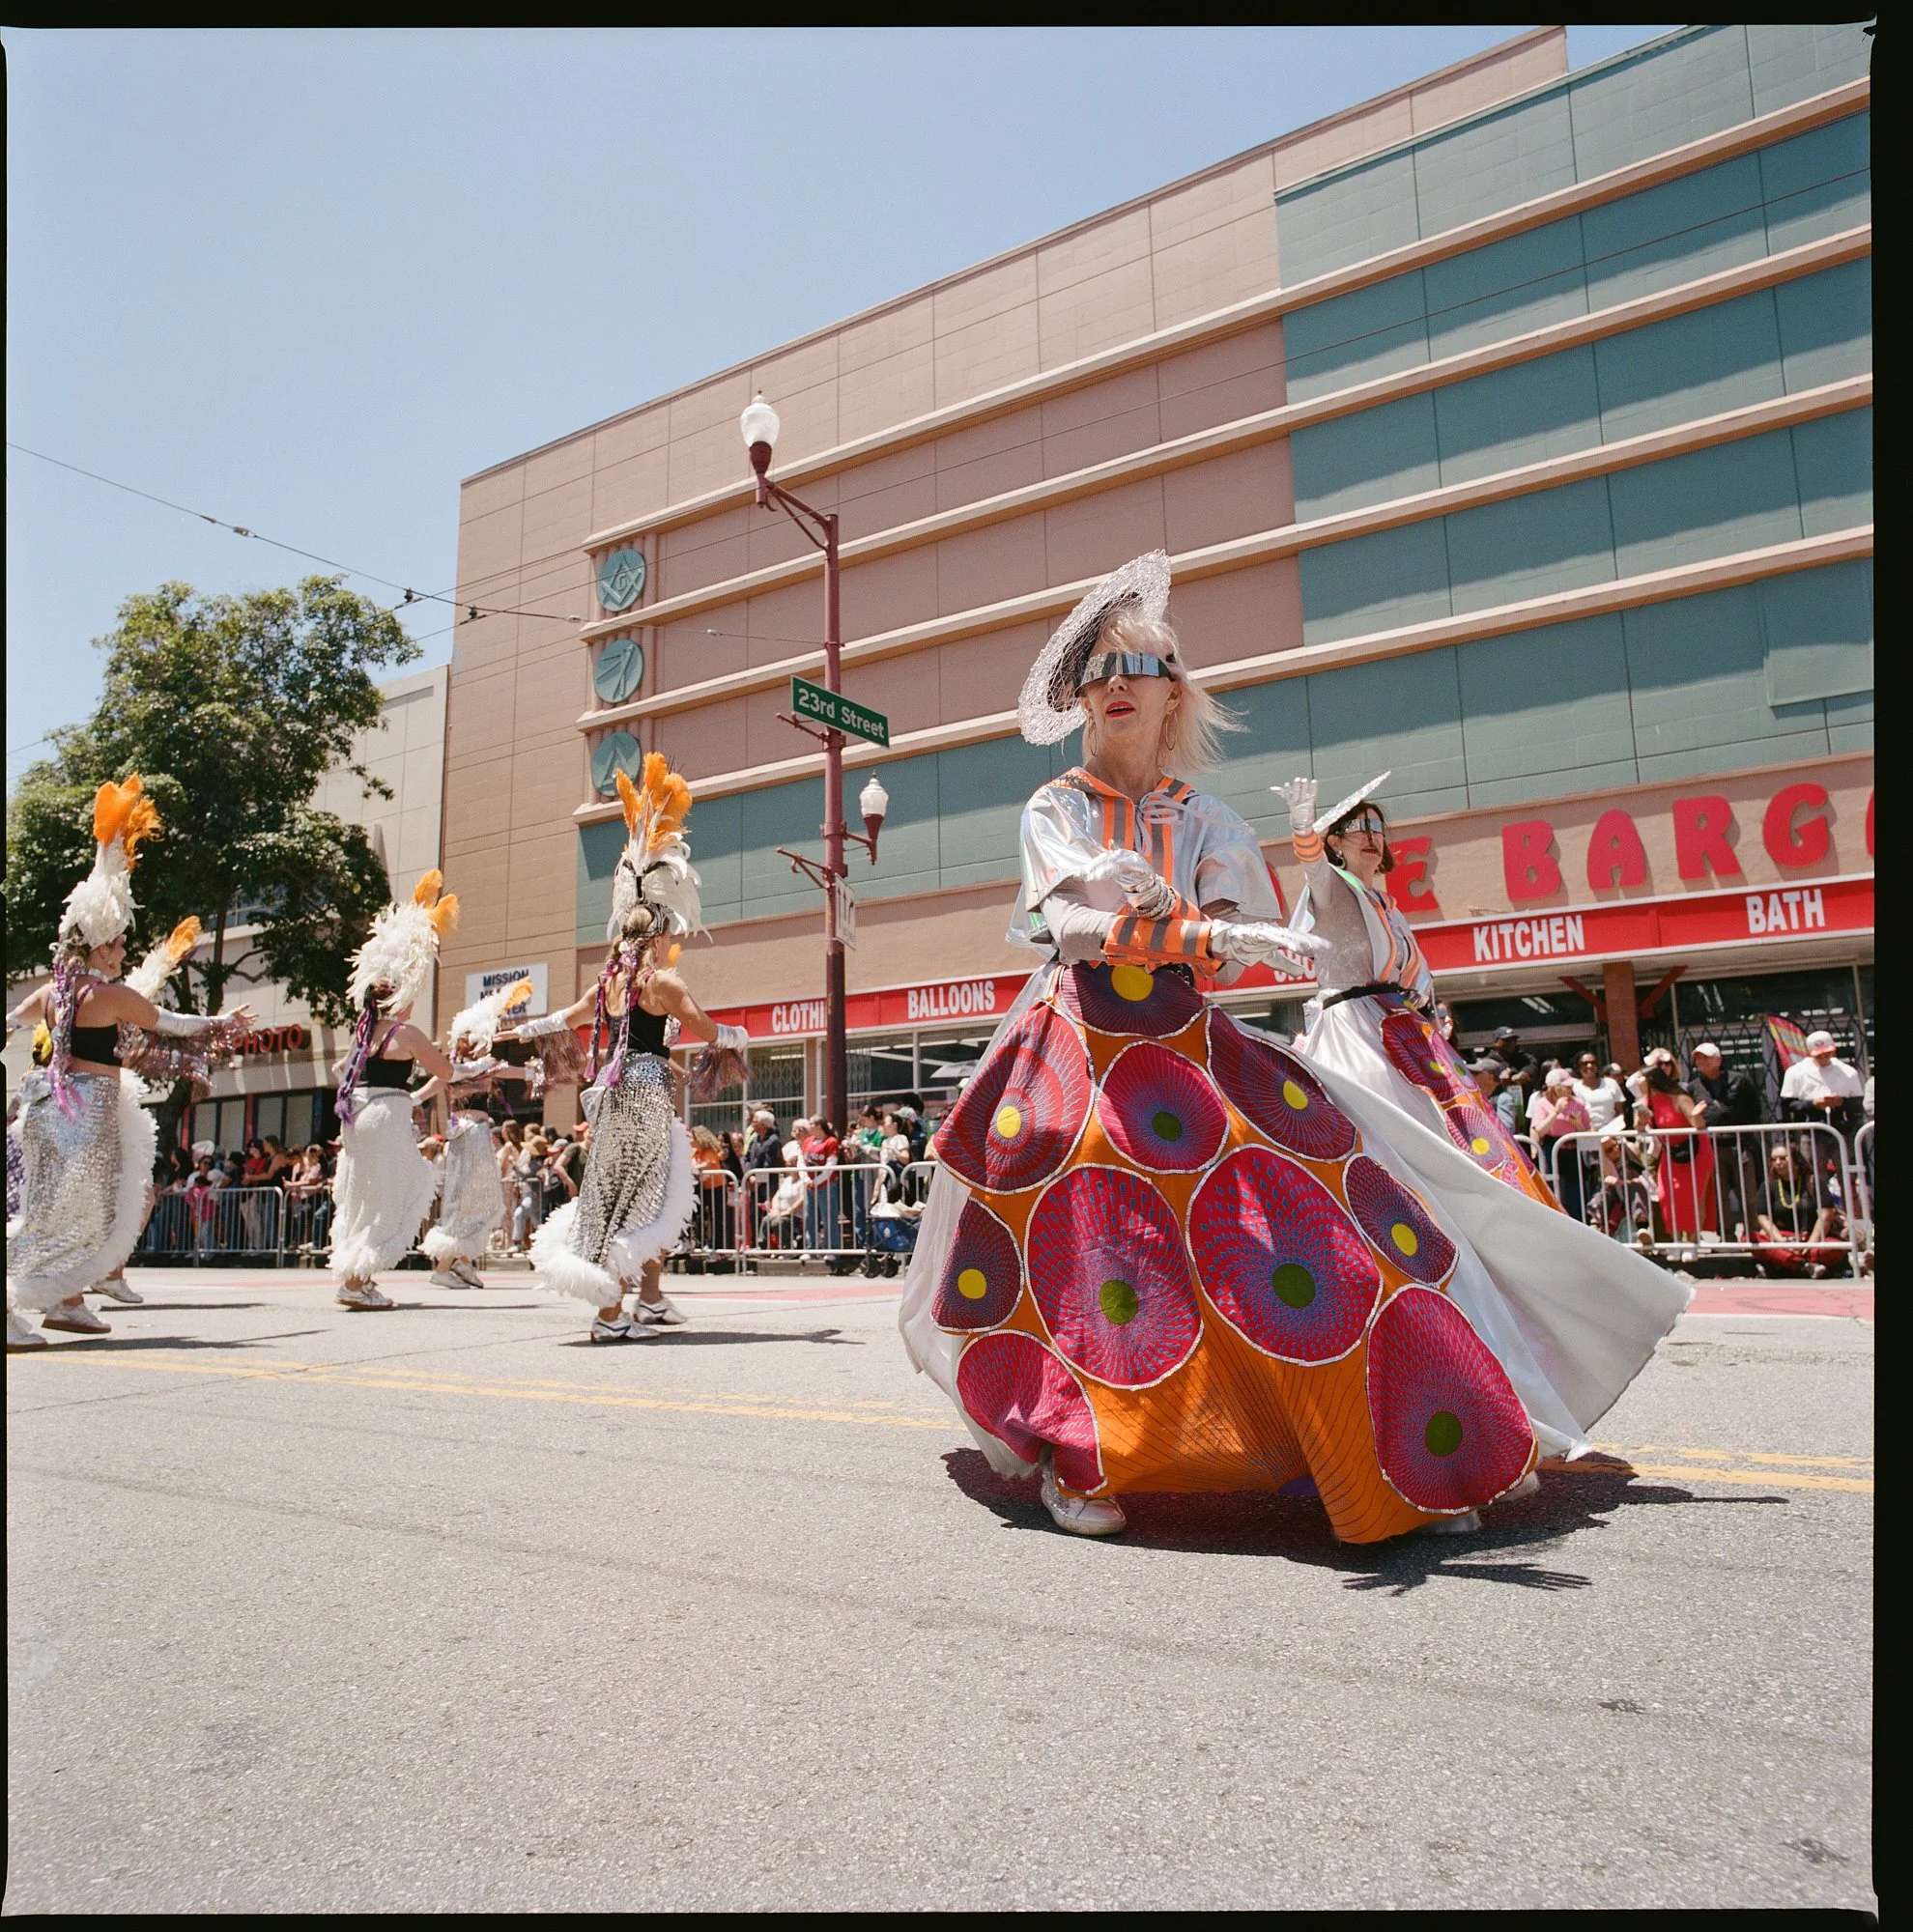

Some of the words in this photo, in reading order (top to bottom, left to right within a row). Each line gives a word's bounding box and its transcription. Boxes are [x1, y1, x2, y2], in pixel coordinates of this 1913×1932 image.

[798, 688, 836, 719] 23rd
[841, 706, 885, 739] Street
[1501, 782, 1874, 901] BARG
[1747, 889, 1825, 934] BATH
[1473, 915, 1585, 962] KITCHEN
[483, 969, 529, 986] MISSION
[772, 1001, 828, 1033] CLOTHI
[907, 980, 995, 1019] BALLOONS
[231, 1024, 302, 1057] PHOTO
